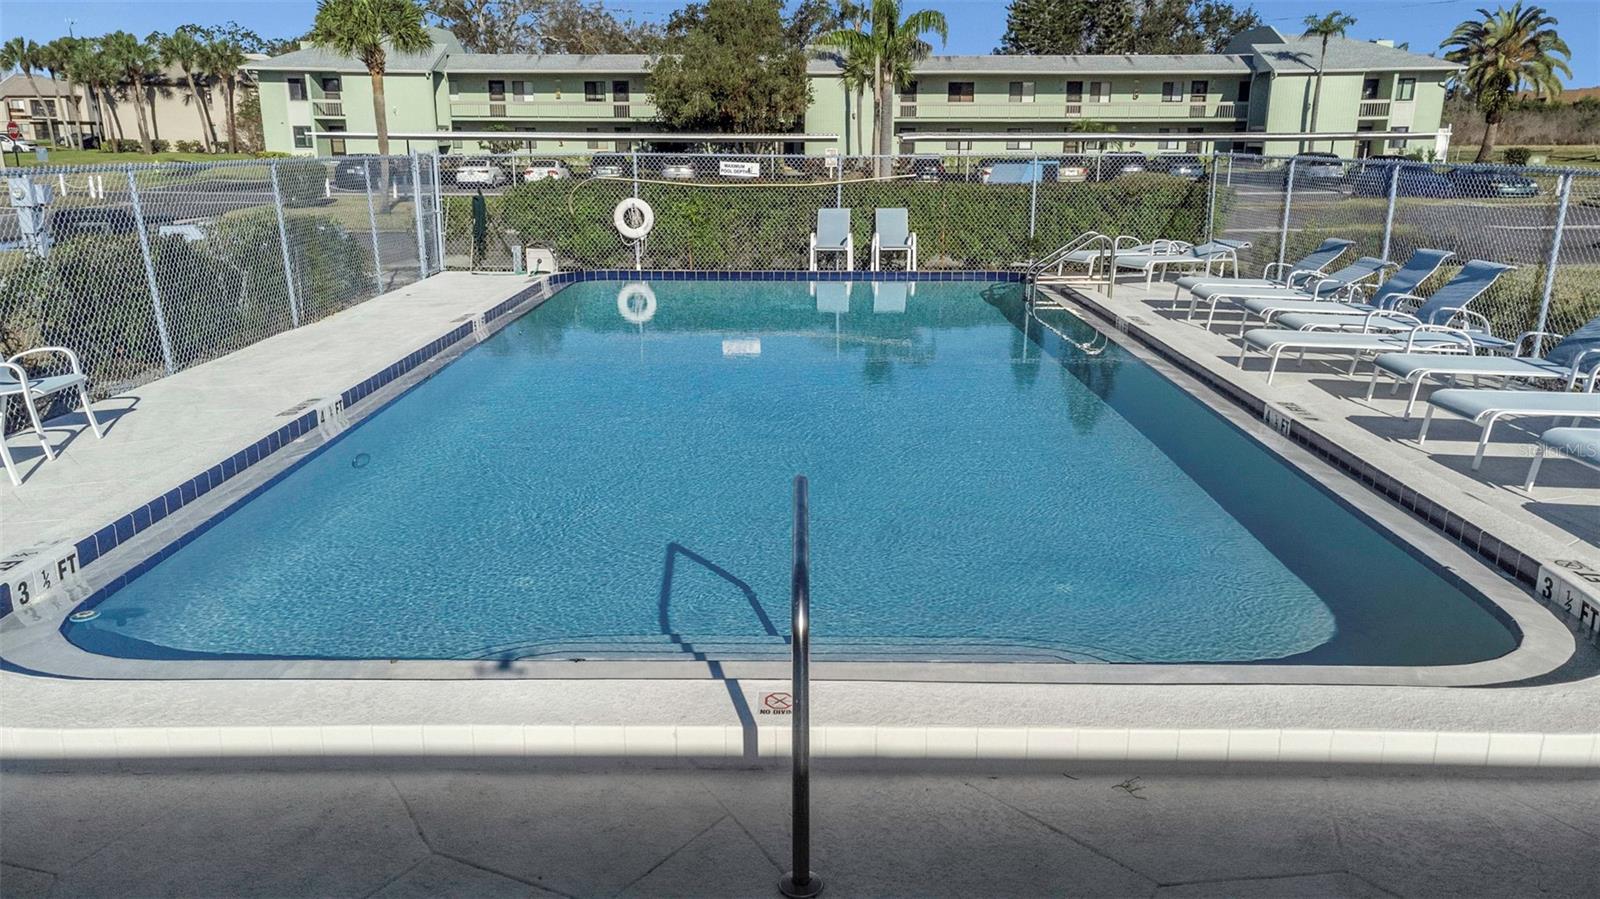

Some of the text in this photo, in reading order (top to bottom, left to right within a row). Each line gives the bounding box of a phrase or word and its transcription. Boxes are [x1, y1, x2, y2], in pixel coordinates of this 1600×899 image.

[335, 400, 342, 414] FT
[1281, 418, 1289, 434] FT
[18, 581, 29, 604] 3
[57, 553, 76, 580] FT
[1542, 576, 1553, 600] 3
[1580, 600, 1599, 630] FT
